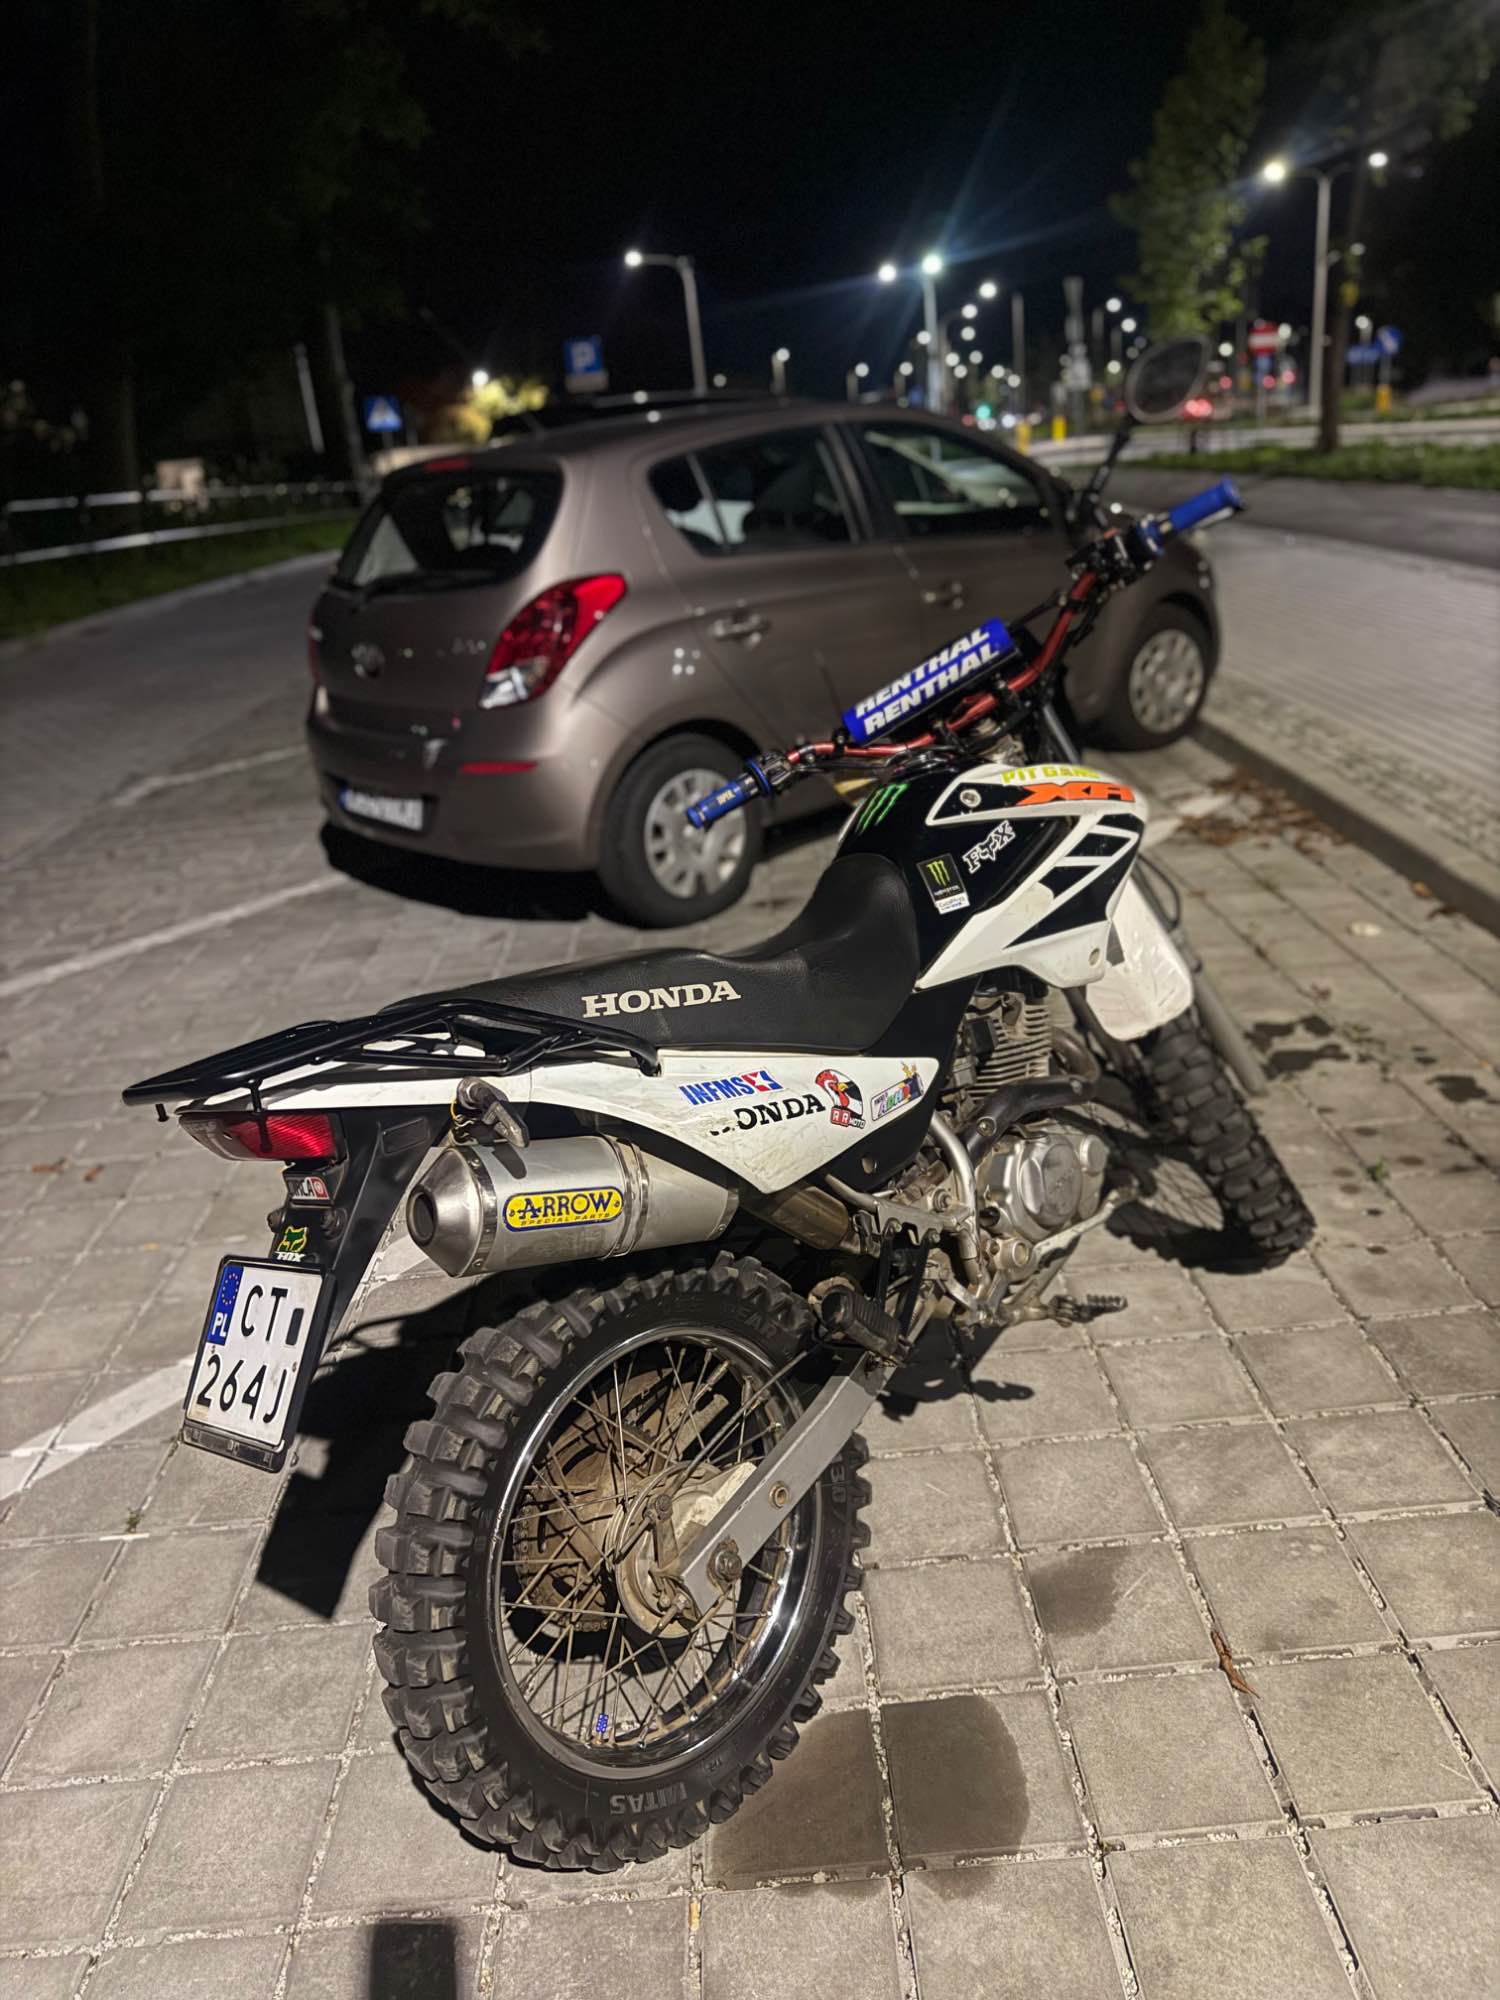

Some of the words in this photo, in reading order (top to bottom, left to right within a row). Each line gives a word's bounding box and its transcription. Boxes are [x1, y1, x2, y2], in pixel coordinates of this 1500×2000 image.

[863, 643, 1000, 736] RENTHAL
[1002, 767, 1038, 784] PIT
[581, 980, 741, 1018] HONDA
[679, 1076, 752, 1105] INFMS
[711, 1093, 826, 1136] ONDA
[517, 1192, 613, 1219] ARROW
[520, 1216, 569, 1226] SPECIAL
[575, 1212, 610, 1221] PARTS
[275, 1251, 306, 1262] FOX
[211, 1312, 228, 1337] PL
[240, 1284, 289, 1342] CT
[196, 1353, 288, 1423] 264J
